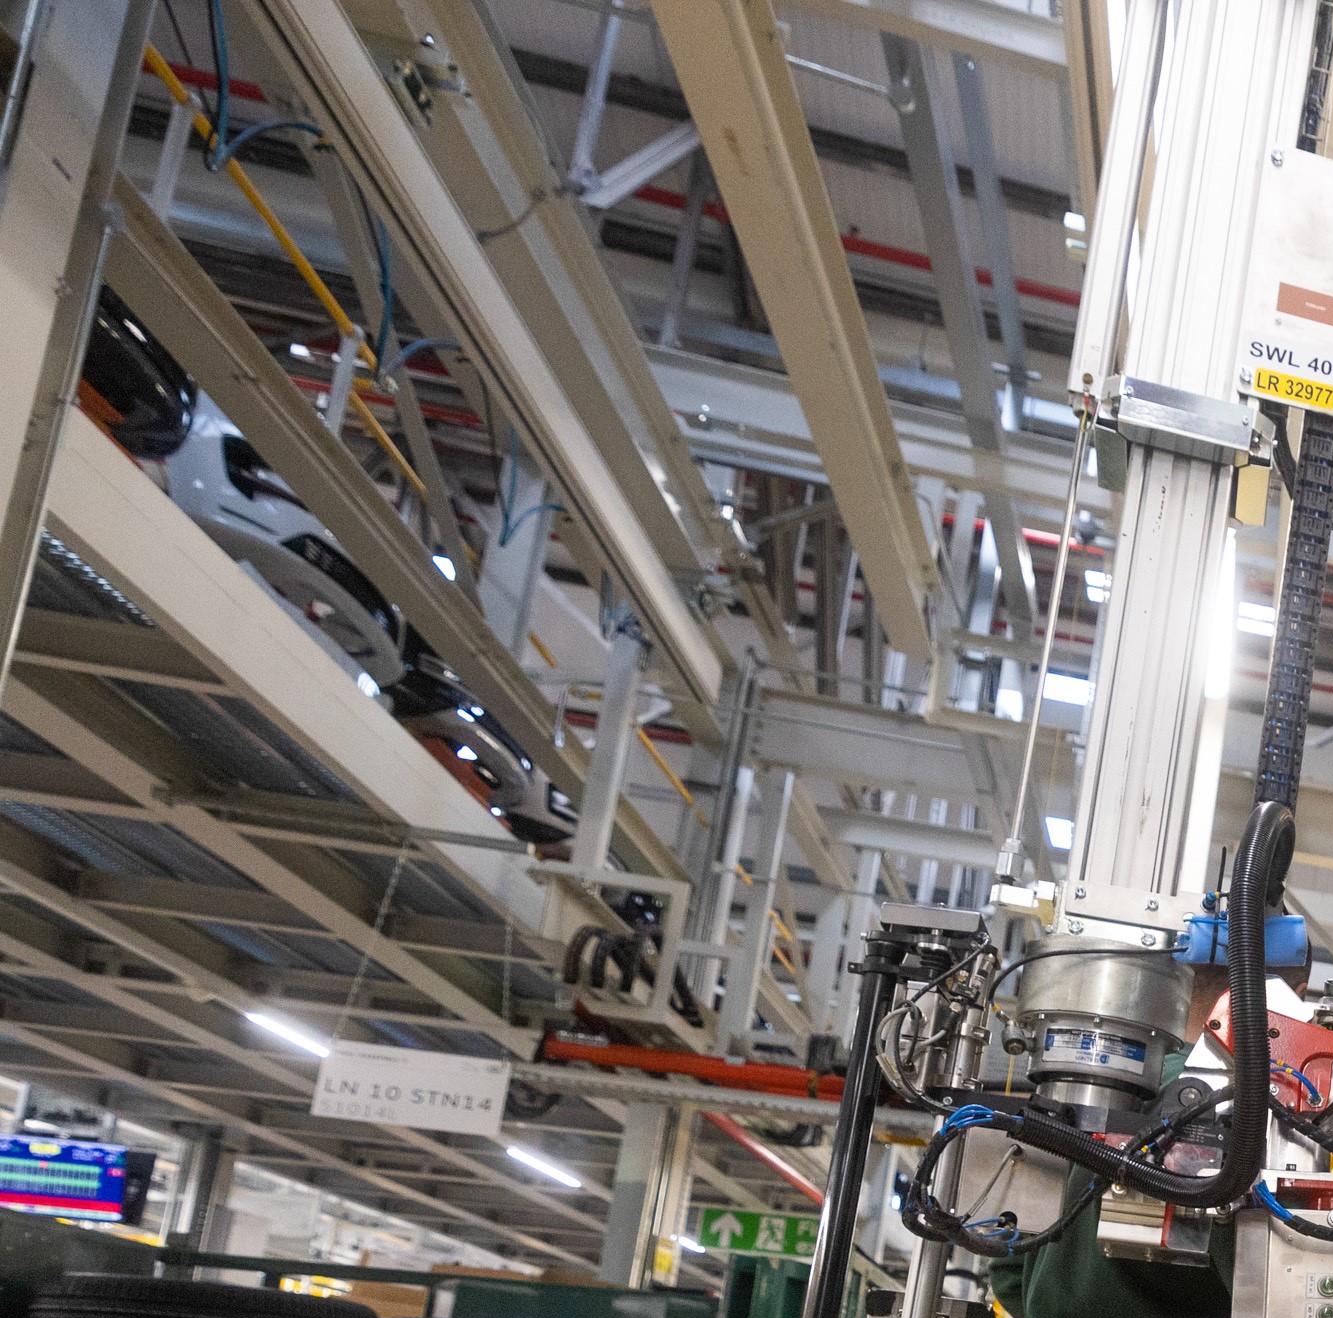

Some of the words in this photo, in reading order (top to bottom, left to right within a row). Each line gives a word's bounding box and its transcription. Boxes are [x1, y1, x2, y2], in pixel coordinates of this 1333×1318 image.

[1250, 341, 1300, 367] SWL
[1257, 372, 1280, 393] LR
[1285, 379, 1333, 404] 32977
[324, 1078, 358, 1095] LN
[370, 1083, 401, 1101] 10
[410, 1088, 492, 1111] STN14
